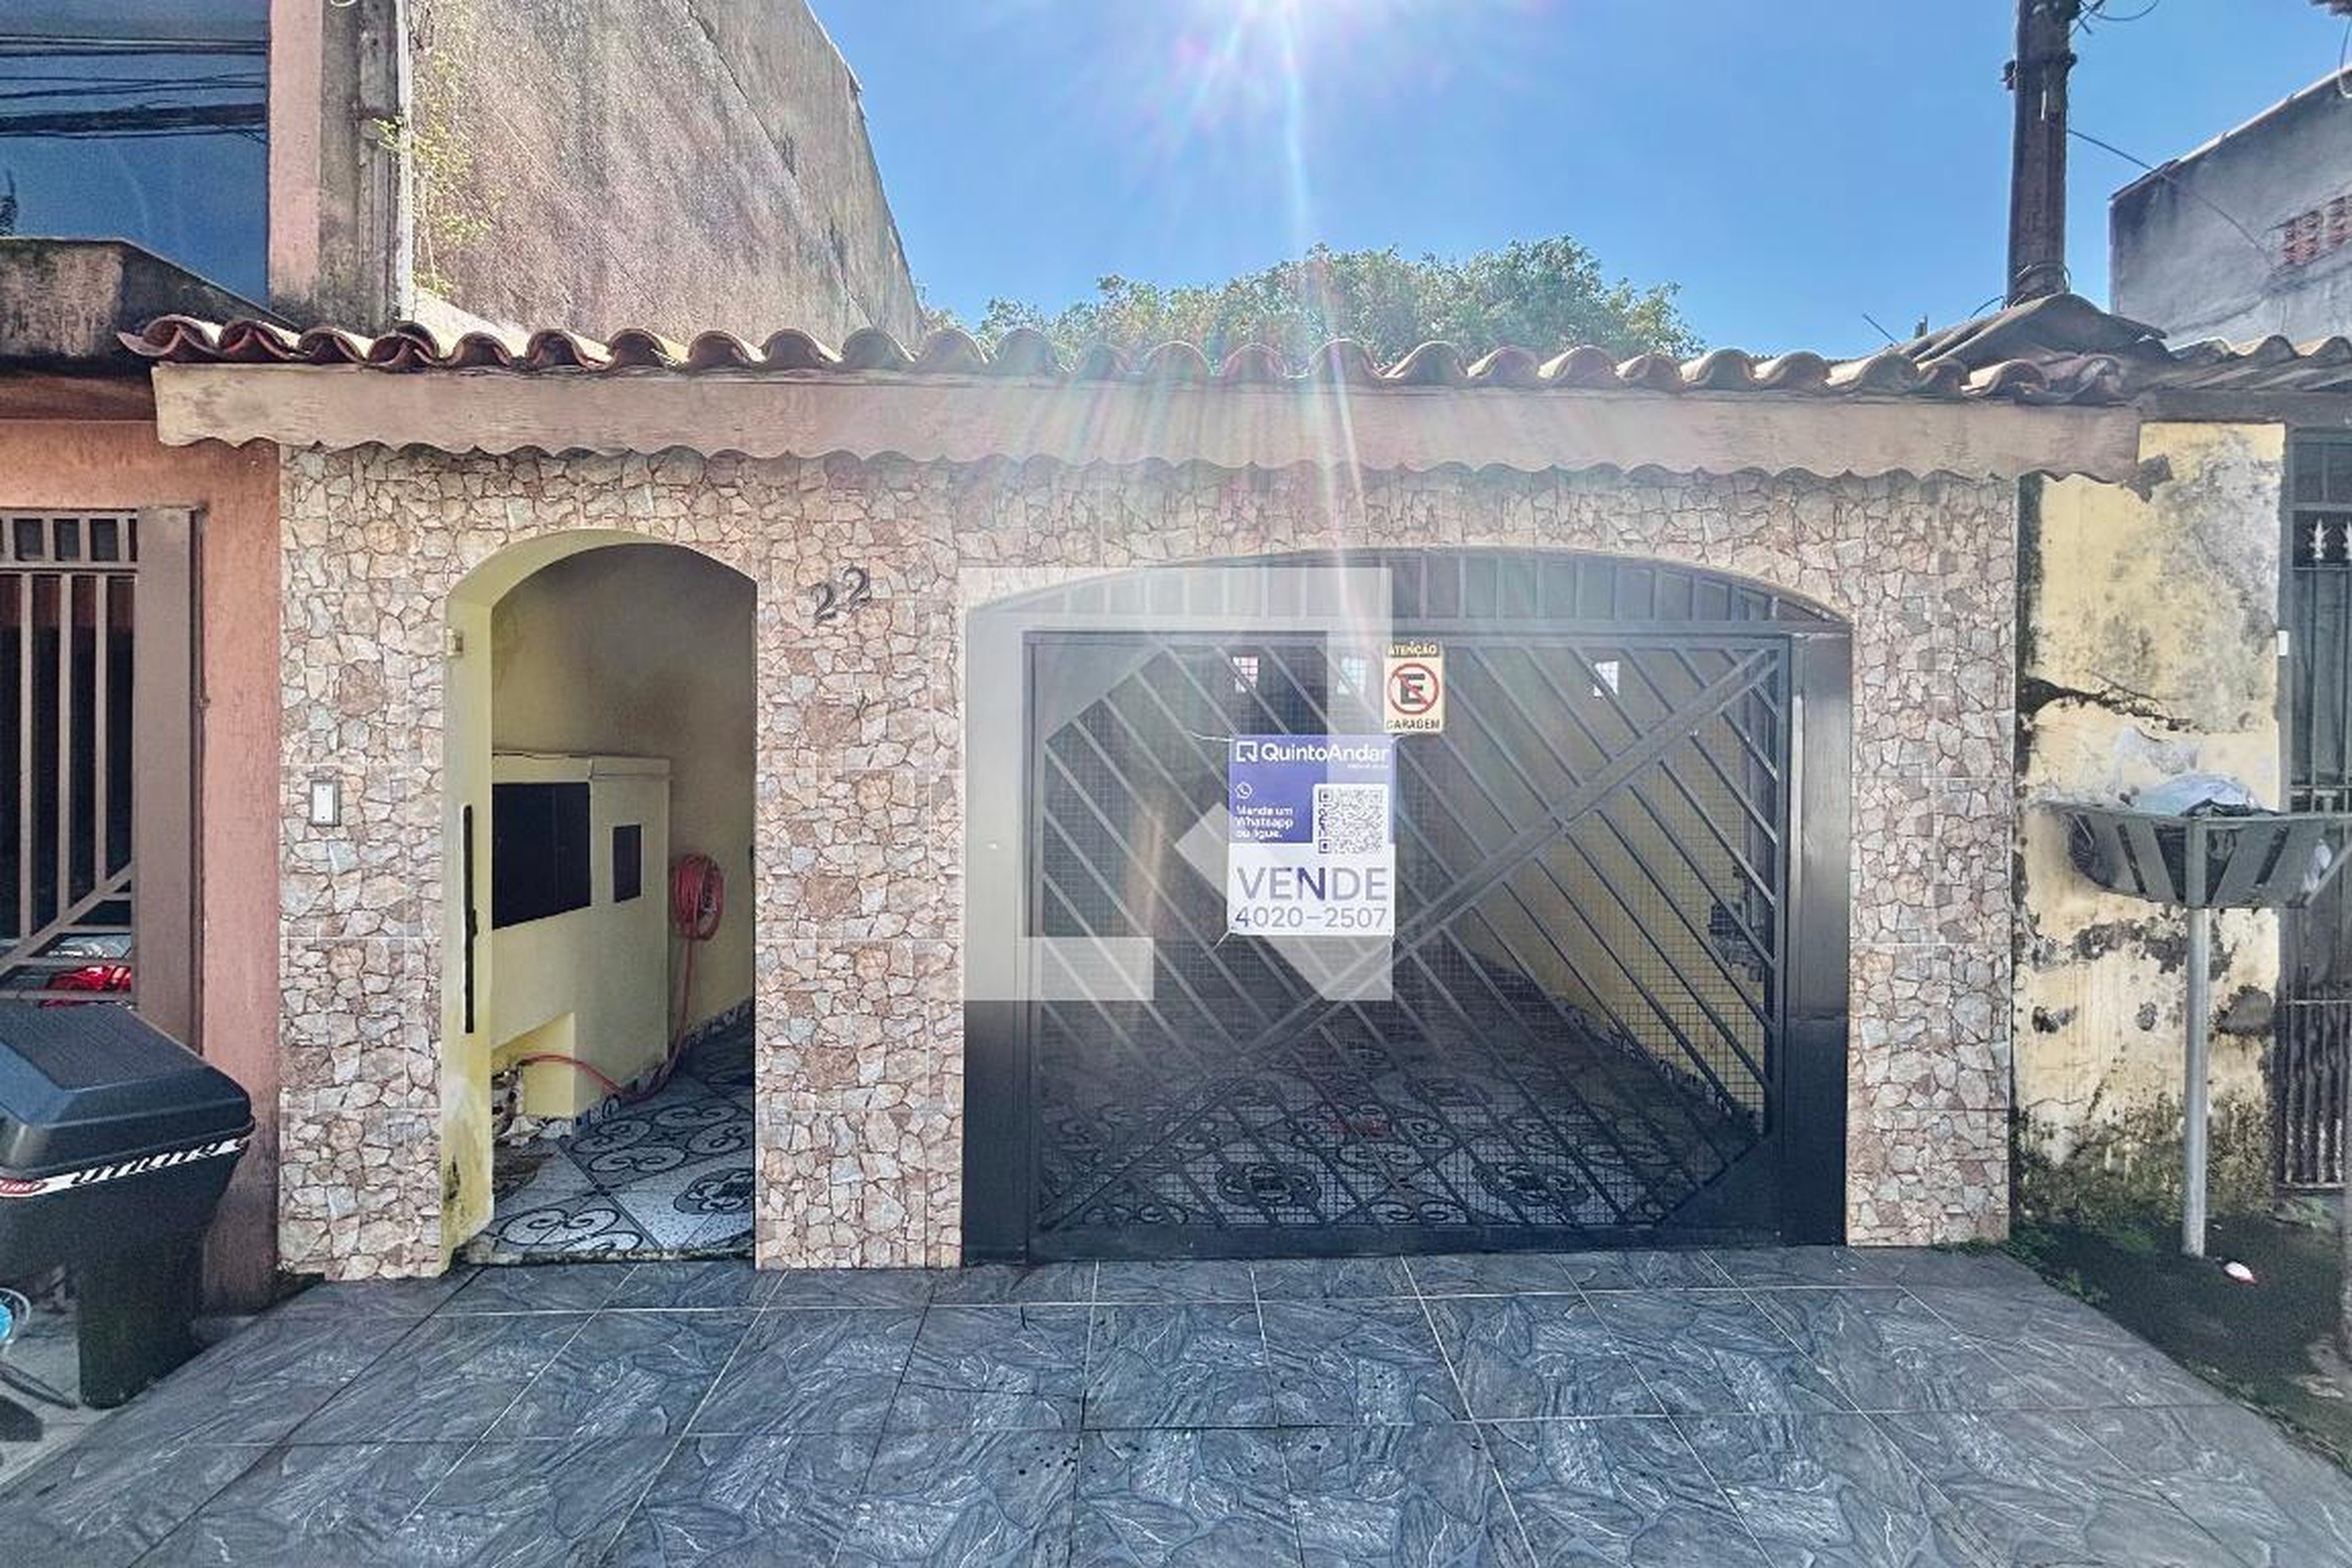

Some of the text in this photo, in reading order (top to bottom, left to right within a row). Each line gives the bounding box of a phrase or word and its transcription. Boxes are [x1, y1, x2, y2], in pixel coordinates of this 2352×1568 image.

[810, 566, 872, 619] 22
[1387, 719, 1440, 729] GARAGEM
[1261, 740, 1389, 762] QuintoAndar
[1275, 807, 1294, 816] um
[1236, 867, 1389, 901] VENDE
[1235, 906, 1388, 929] 4020-2507
